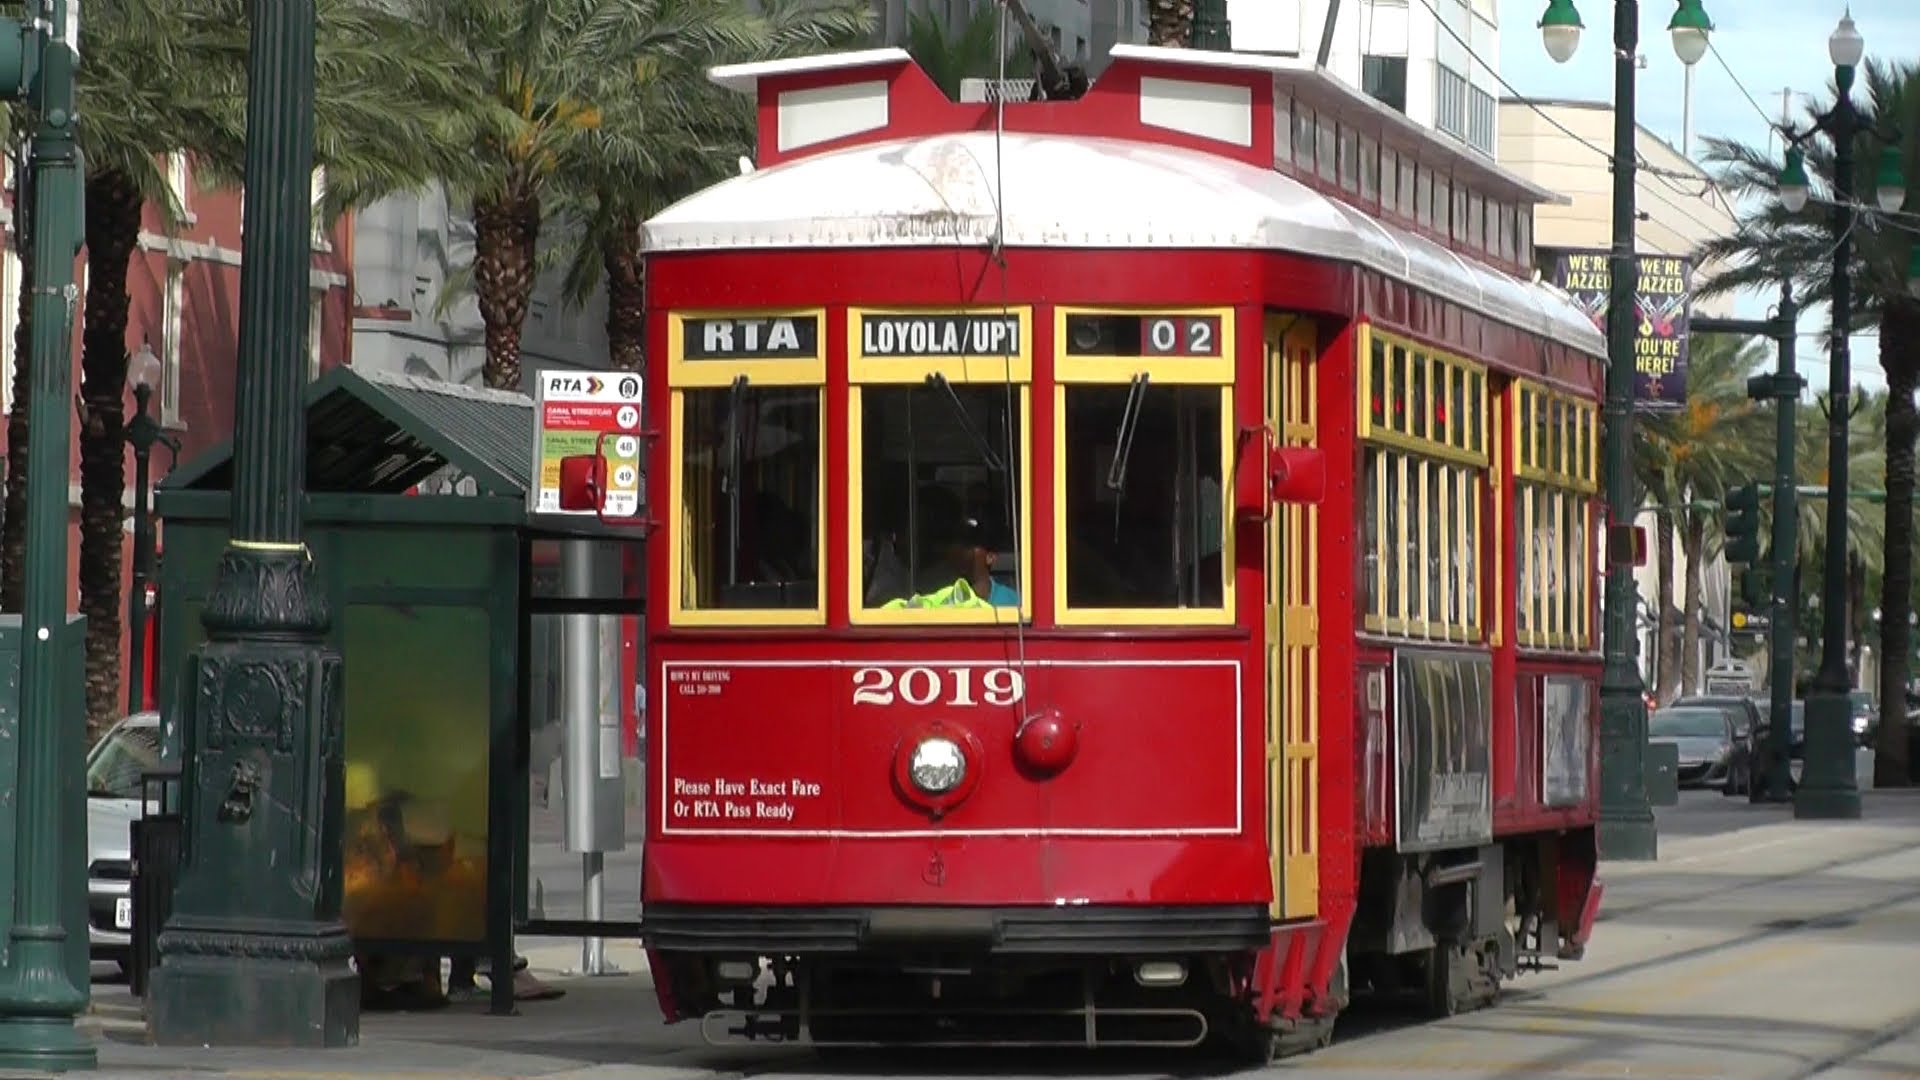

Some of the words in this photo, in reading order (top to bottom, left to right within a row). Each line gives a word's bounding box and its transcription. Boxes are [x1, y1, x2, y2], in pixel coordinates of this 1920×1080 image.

[1641, 258, 1682, 275] WE'RE
[1566, 271, 1612, 290] JAZZED
[1637, 275, 1684, 293] JAZZED
[703, 319, 799, 351] RTA
[1634, 337, 1680, 356] YOU'RE
[1636, 356, 1675, 373] HERE!
[550, 378, 582, 392] RTA
[621, 411, 634, 423] 47
[619, 442, 633, 454] 48
[618, 471, 632, 482] 49
[852, 667, 1024, 706] 2019
[674, 777, 711, 795] Please
[715, 778, 745, 795] Have
[750, 778, 786, 796] Exact
[792, 779, 821, 796] Fare
[674, 800, 689, 817] Or
[694, 801, 720, 817] RTA
[725, 801, 751, 817] Pass
[756, 802, 794, 821] Ready
